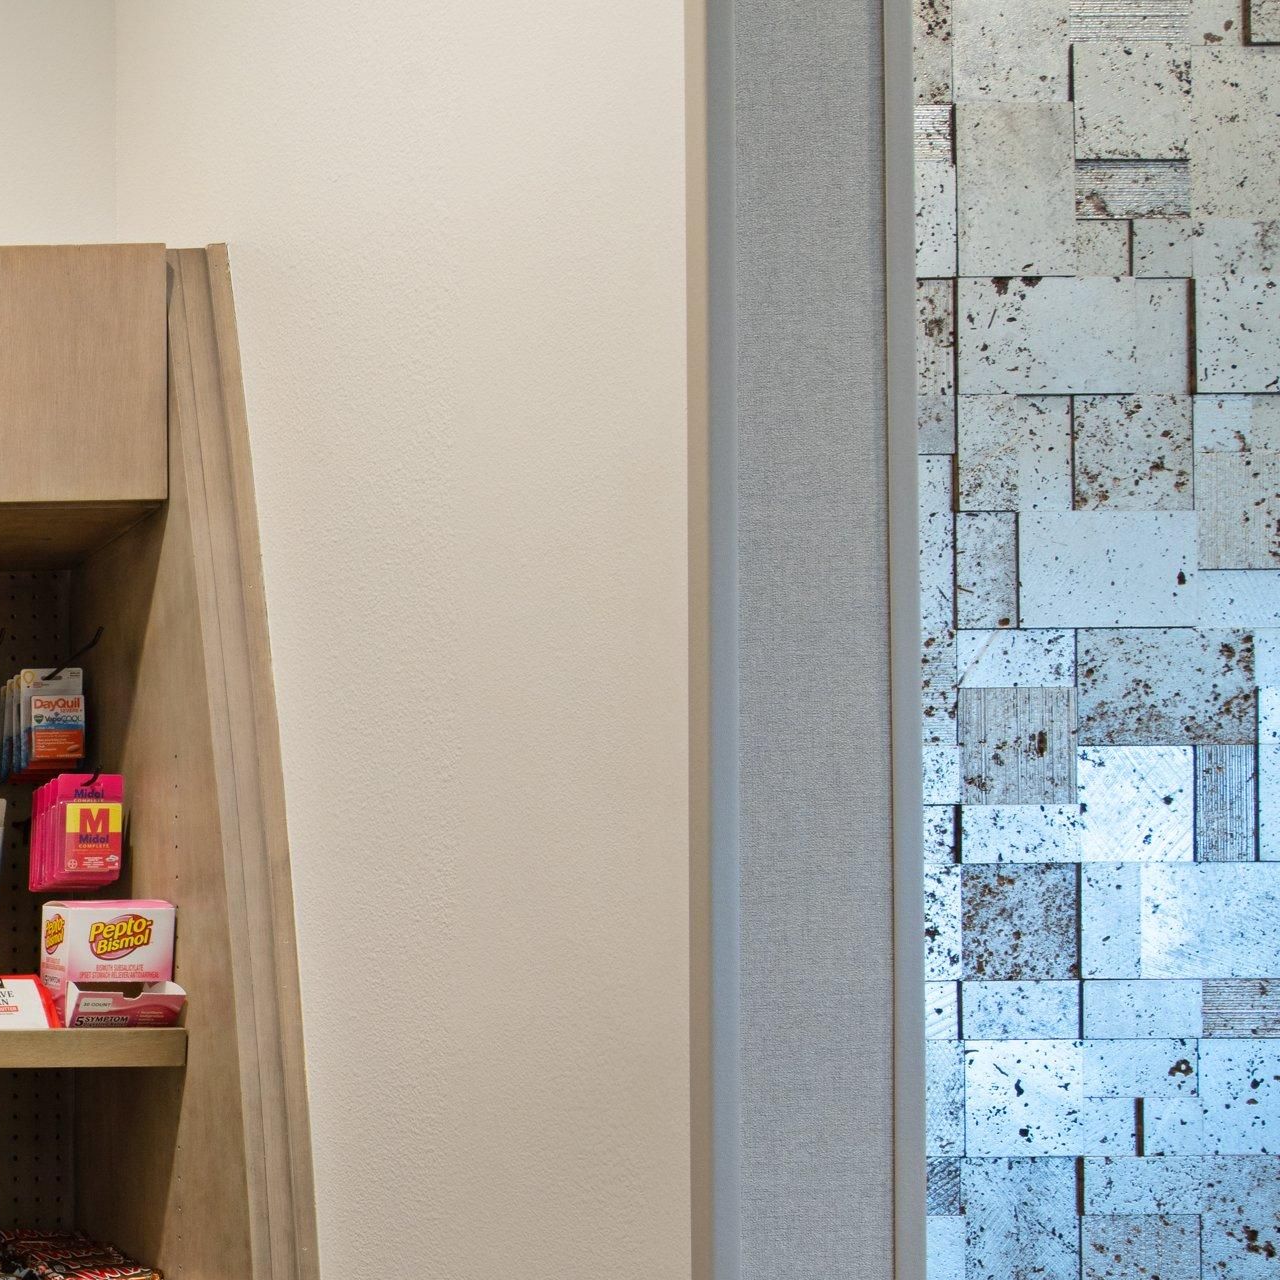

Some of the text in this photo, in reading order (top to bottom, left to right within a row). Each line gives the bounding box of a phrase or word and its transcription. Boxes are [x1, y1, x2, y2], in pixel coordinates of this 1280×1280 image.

[33, 698, 81, 712] DayQuil
[75, 788, 104, 799] Midol
[79, 809, 110, 833] M
[89, 917, 152, 941] Pepto-
[96, 935, 151, 955] Bismol
[84, 1015, 128, 1024] SYMPTOM
